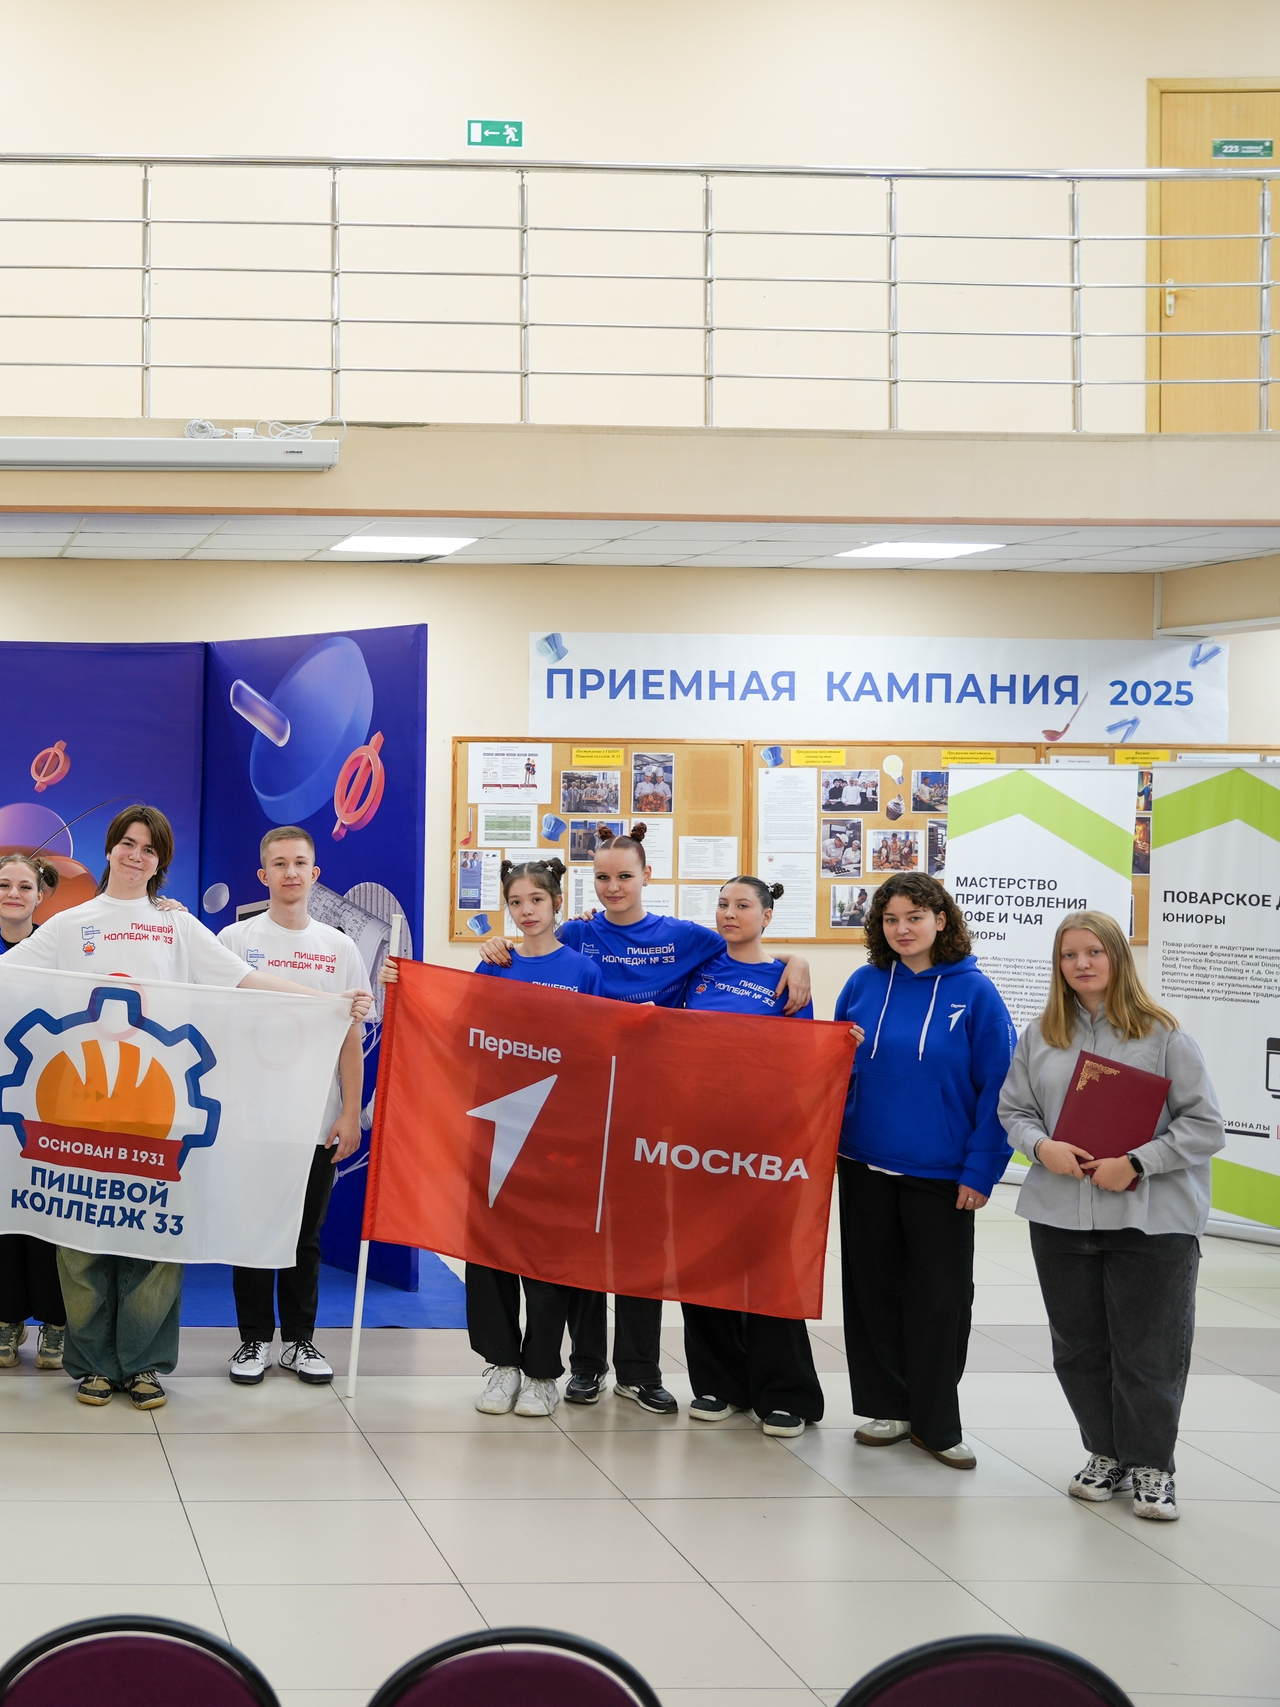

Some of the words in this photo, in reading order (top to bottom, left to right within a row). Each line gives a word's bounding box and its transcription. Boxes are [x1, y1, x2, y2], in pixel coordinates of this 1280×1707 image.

[546, 668, 796, 701] ПРИЕМНАЯ
[826, 671, 1079, 705] КАМПАНИЯ
[1109, 680, 1194, 706] 2025
[956, 876, 1058, 891] МАСТЕРСТВО
[955, 893, 1087, 909] ПРИГОТОВЛЕНИЯ
[1163, 890, 1272, 907] ПОВАРСКОЕ
[964, 910, 994, 922] ОФЕ
[999, 912, 1008, 923] И
[1013, 913, 1043, 925] ЧАЯ
[1162, 912, 1226, 925] ЮНИОРЫ
[131, 923, 173, 934] ПИЩЕВОЙ
[972, 930, 1006, 940] ИОРЫ
[627, 943, 674, 955] ПИЩЕВОЙ
[268, 960, 312, 969] КОЛЛЕДЖ
[294, 952, 336, 963] ПИЩЕВОЙ
[739, 980, 775, 997] ПИЩЕВО
[762, 997, 775, 1007] 33
[468, 1027, 562, 1064] Первые
[38, 1136, 113, 1159] ОСНОВАН
[118, 1147, 128, 1160] В
[132, 1150, 164, 1166] 1931
[634, 1137, 810, 1182] МОСКВА
[31, 1166, 168, 1207] ПИЩЕВОЙ
[11, 1188, 146, 1230] КОЛЛЕДЖ
[153, 1212, 184, 1236] 33
